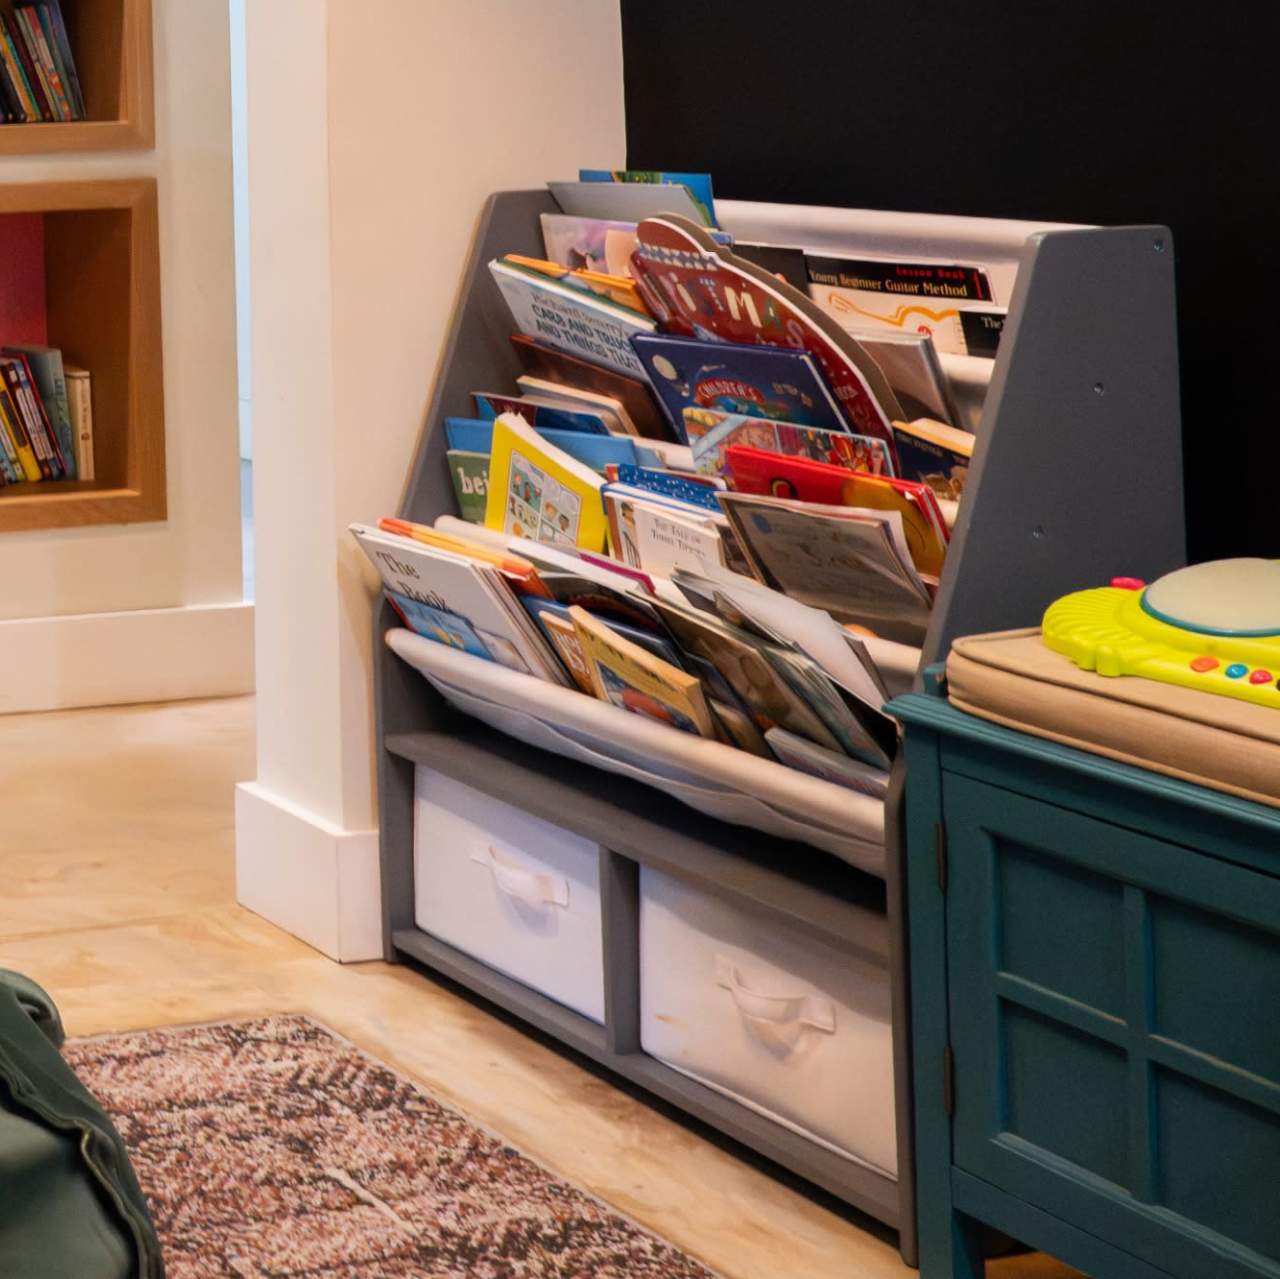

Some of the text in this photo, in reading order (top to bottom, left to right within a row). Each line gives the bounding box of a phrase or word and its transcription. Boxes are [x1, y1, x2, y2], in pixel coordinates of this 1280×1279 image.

[809, 269, 968, 298] Young Beginner Guitar Method
[896, 265, 967, 281] Lesson Book
[531, 304, 567, 328] CARS
[567, 318, 594, 338] AND
[535, 319, 561, 339] AND
[561, 327, 609, 358] THINGS
[455, 466, 488, 496] bei
[376, 550, 420, 580] The
